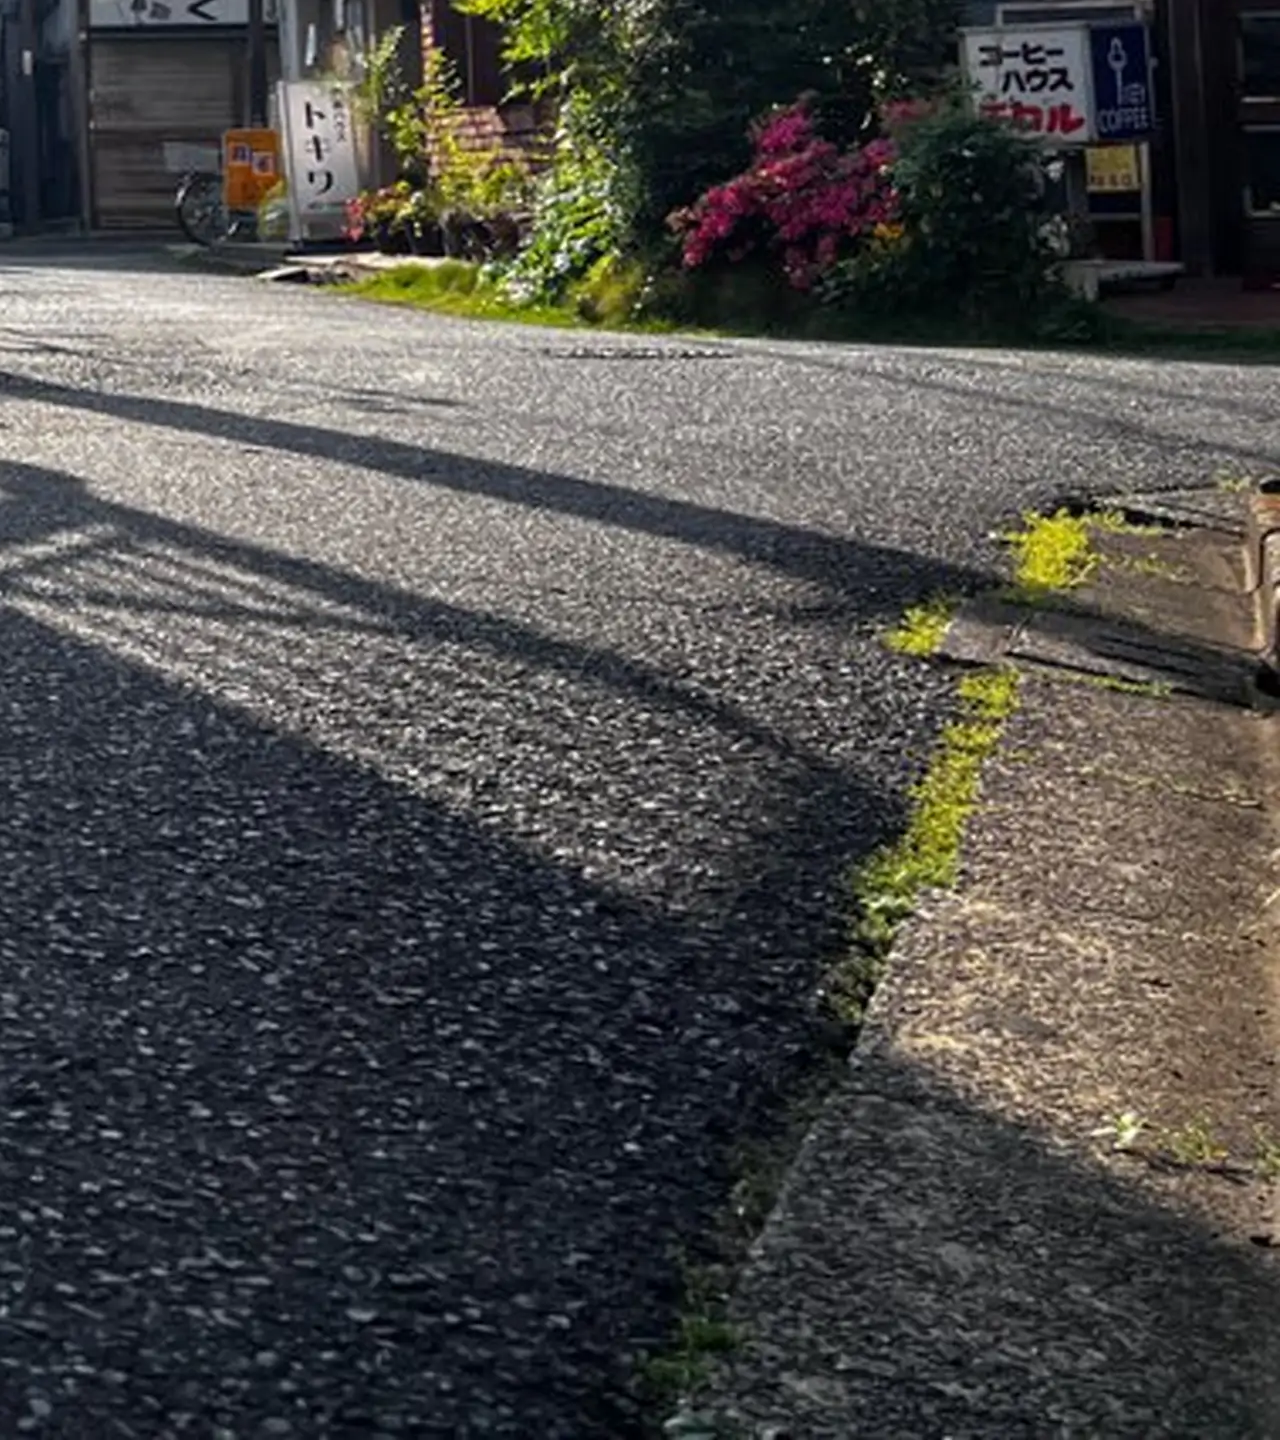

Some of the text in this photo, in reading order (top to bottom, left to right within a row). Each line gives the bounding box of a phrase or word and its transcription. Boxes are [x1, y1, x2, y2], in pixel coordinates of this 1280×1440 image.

[978, 41, 1065, 67] コーヒー
[1001, 67, 1076, 94] ハウス
[304, 101, 334, 196] トキワ
